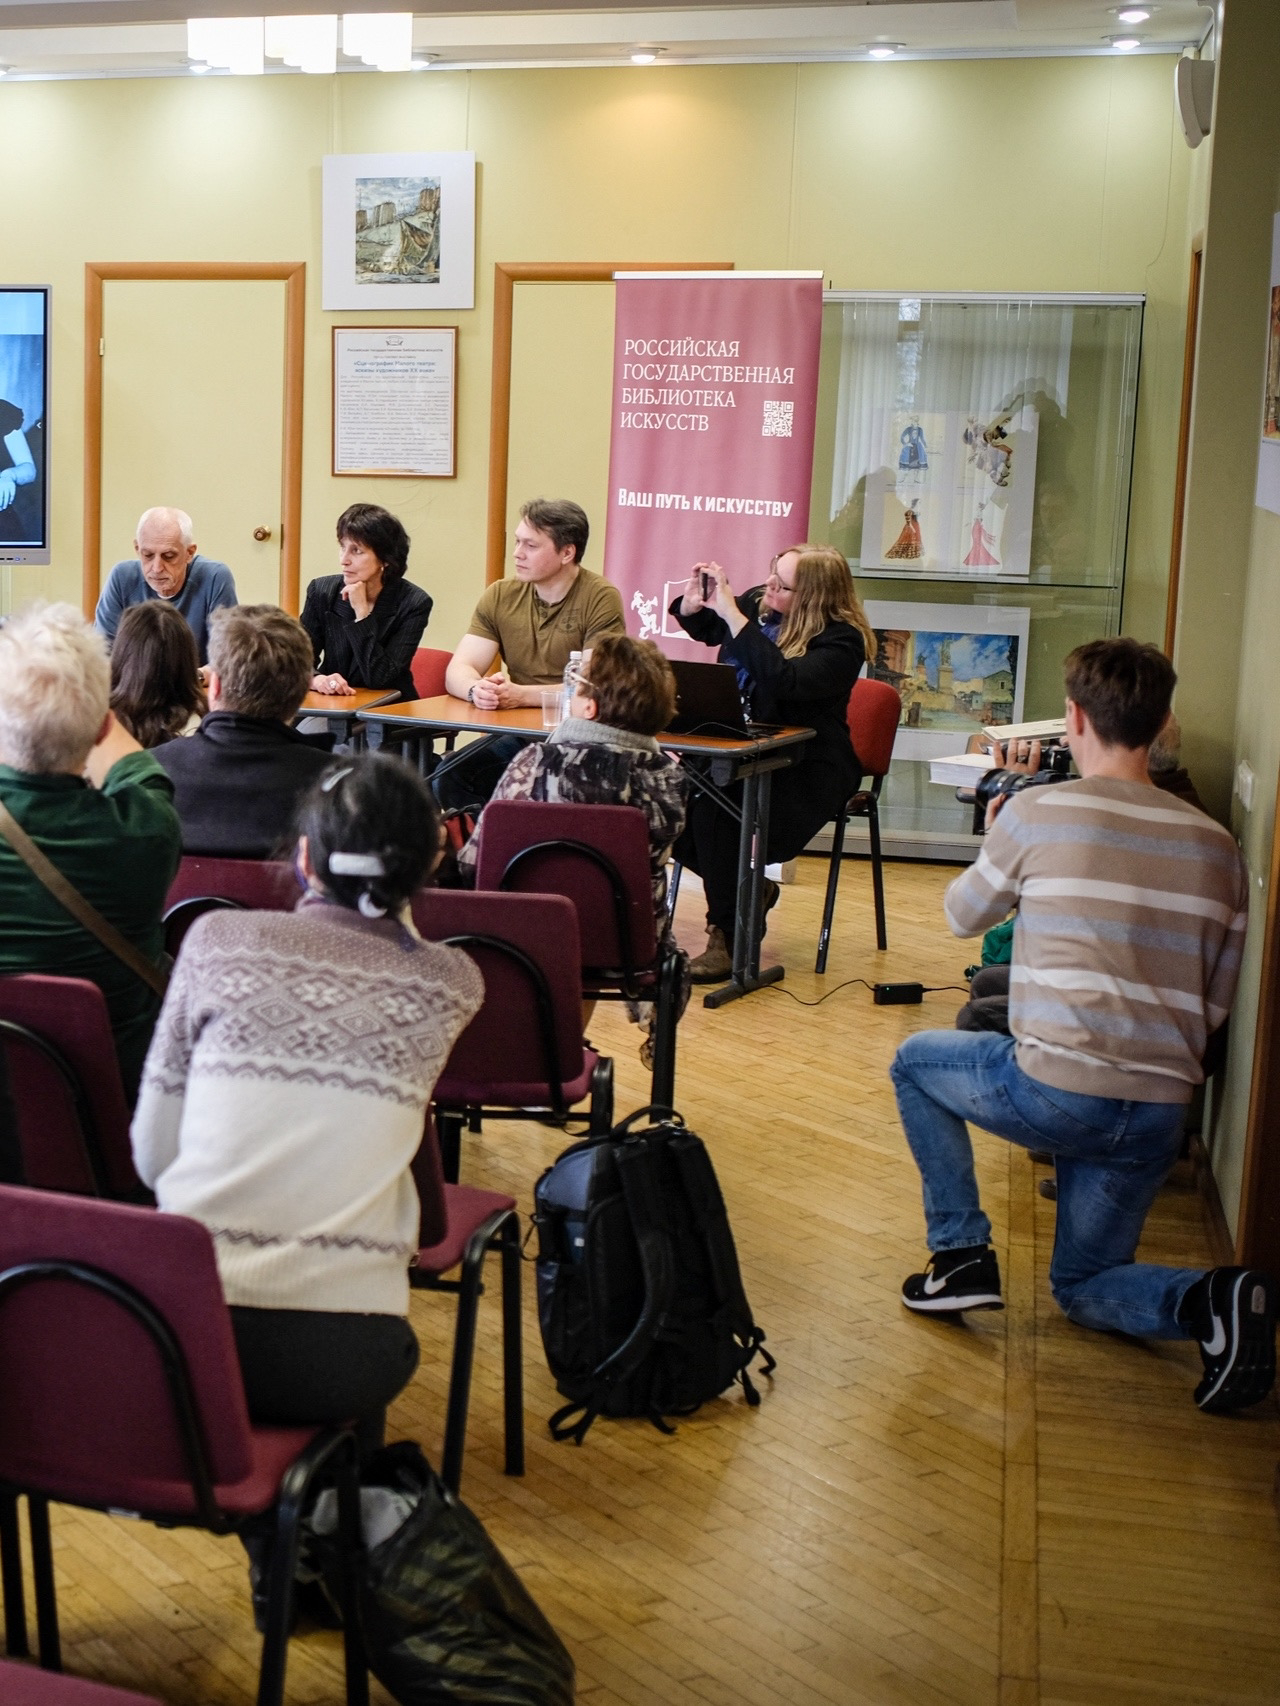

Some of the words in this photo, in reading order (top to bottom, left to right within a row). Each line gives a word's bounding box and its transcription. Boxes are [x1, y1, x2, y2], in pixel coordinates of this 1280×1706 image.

[624, 337, 740, 358] РОССИЙСКАЯ
[623, 363, 795, 385] ГОСУДАРСТВЕННАЯ
[622, 387, 736, 408] БИБЛИОТЕКА
[620, 412, 709, 431] ИСКУССТВ
